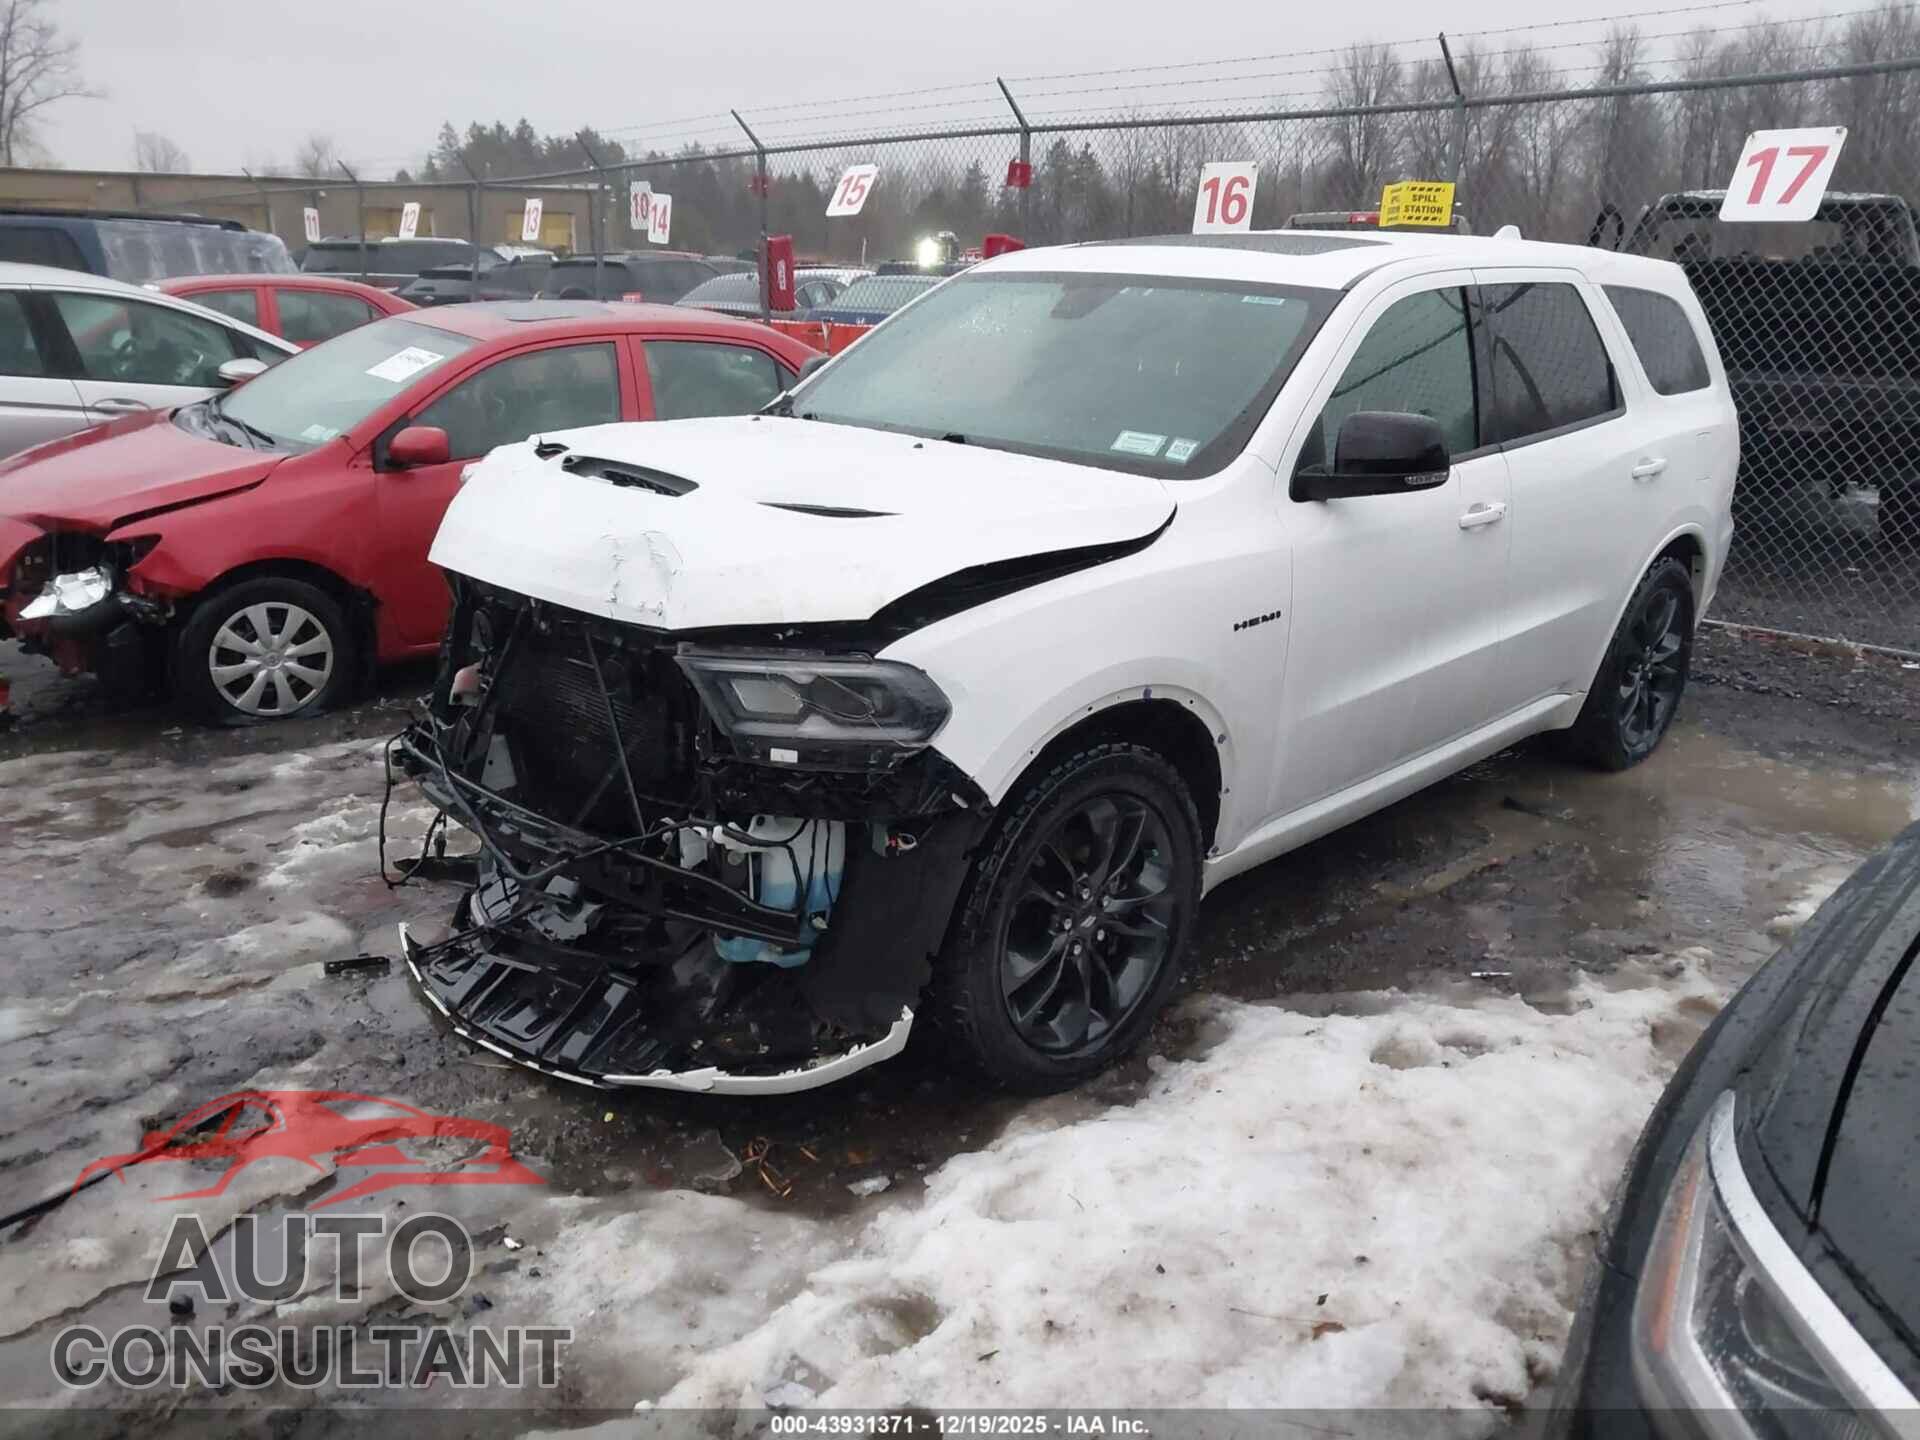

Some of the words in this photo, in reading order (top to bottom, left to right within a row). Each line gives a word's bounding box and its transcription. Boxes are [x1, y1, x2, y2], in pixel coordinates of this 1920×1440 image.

[1746, 145, 1830, 205] 17
[836, 173, 870, 207] 15
[1202, 175, 1250, 225] 16
[1411, 194, 1438, 203] SPILL
[632, 192, 649, 220] 10
[650, 203, 668, 235] 14
[1404, 205, 1444, 214] STATION
[306, 214, 318, 237] 11
[402, 208, 417, 232] 12
[525, 207, 539, 233] 13
[1233, 610, 1282, 632] HEMI
